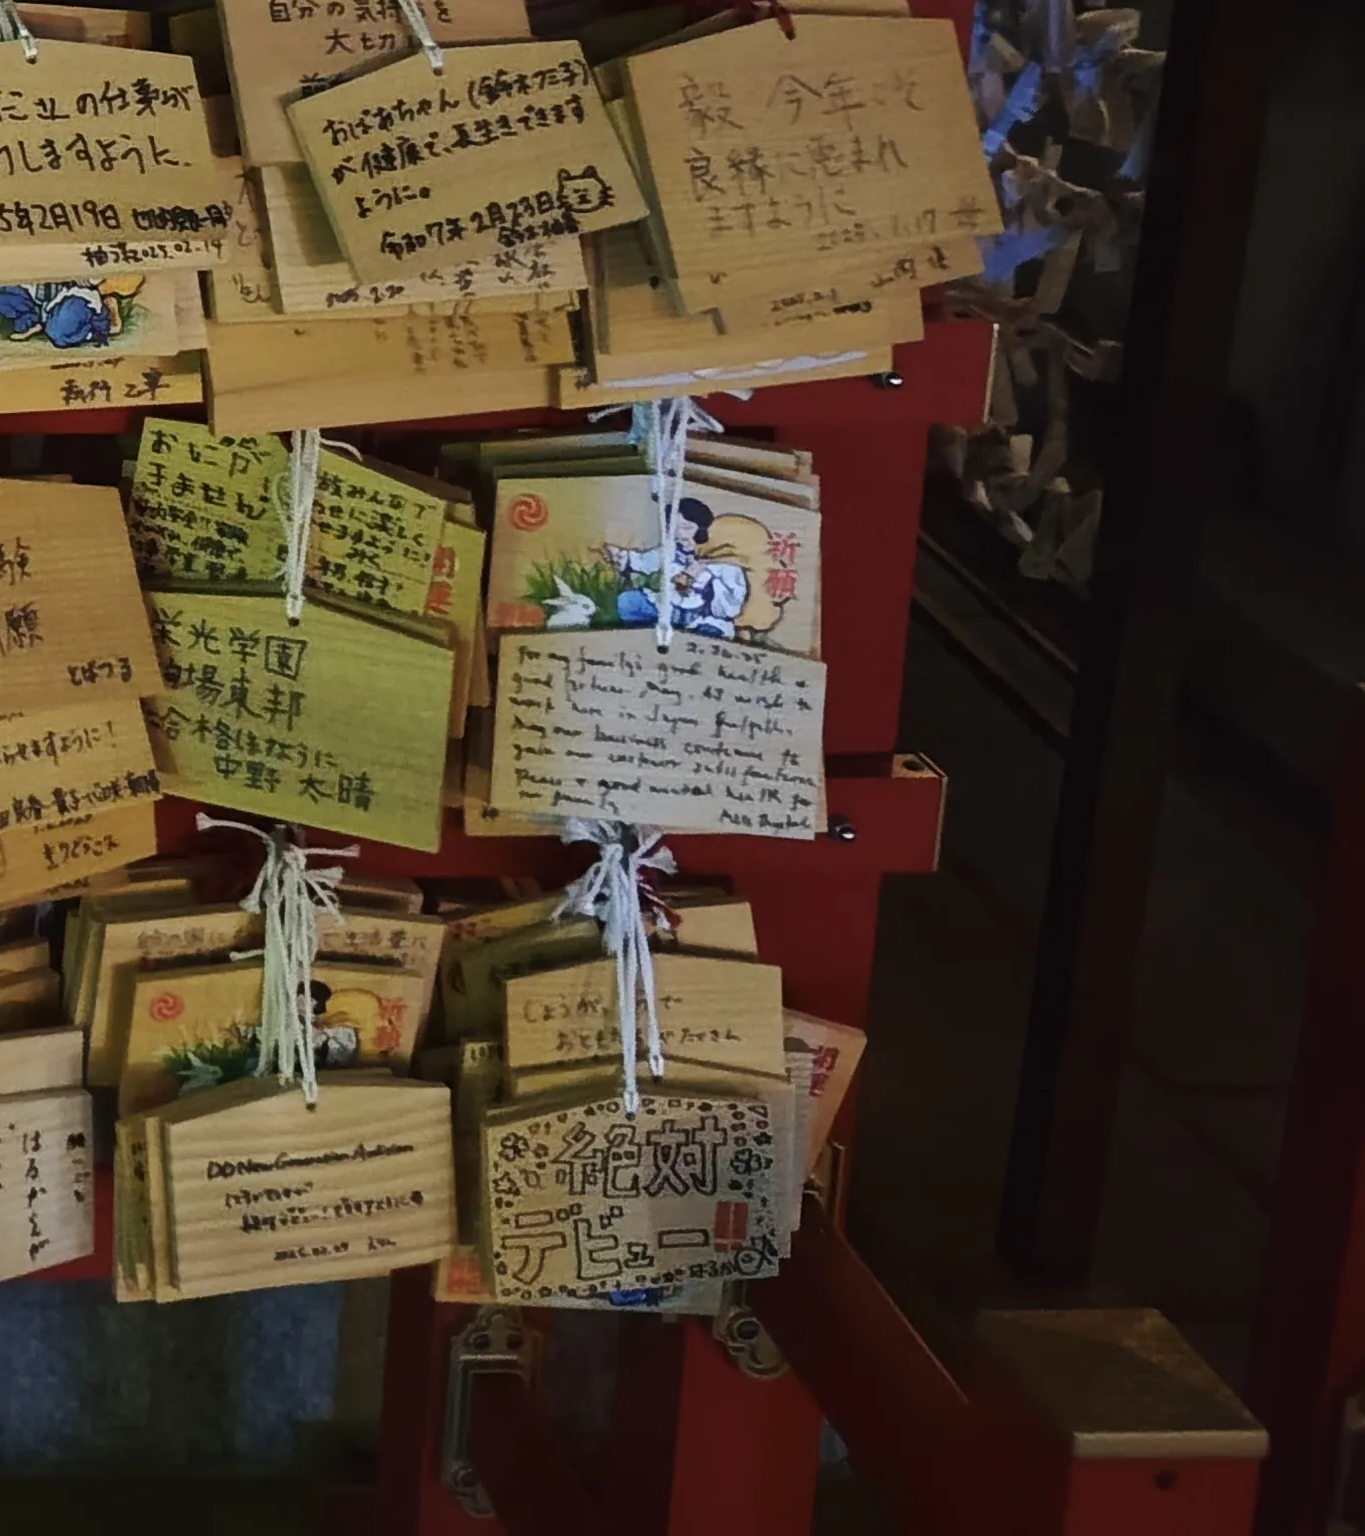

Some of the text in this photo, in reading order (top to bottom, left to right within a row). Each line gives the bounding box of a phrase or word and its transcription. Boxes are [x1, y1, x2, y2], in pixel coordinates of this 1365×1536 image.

[550, 1116, 729, 1199] 絶対
[501, 1203, 712, 1285] デビュー
